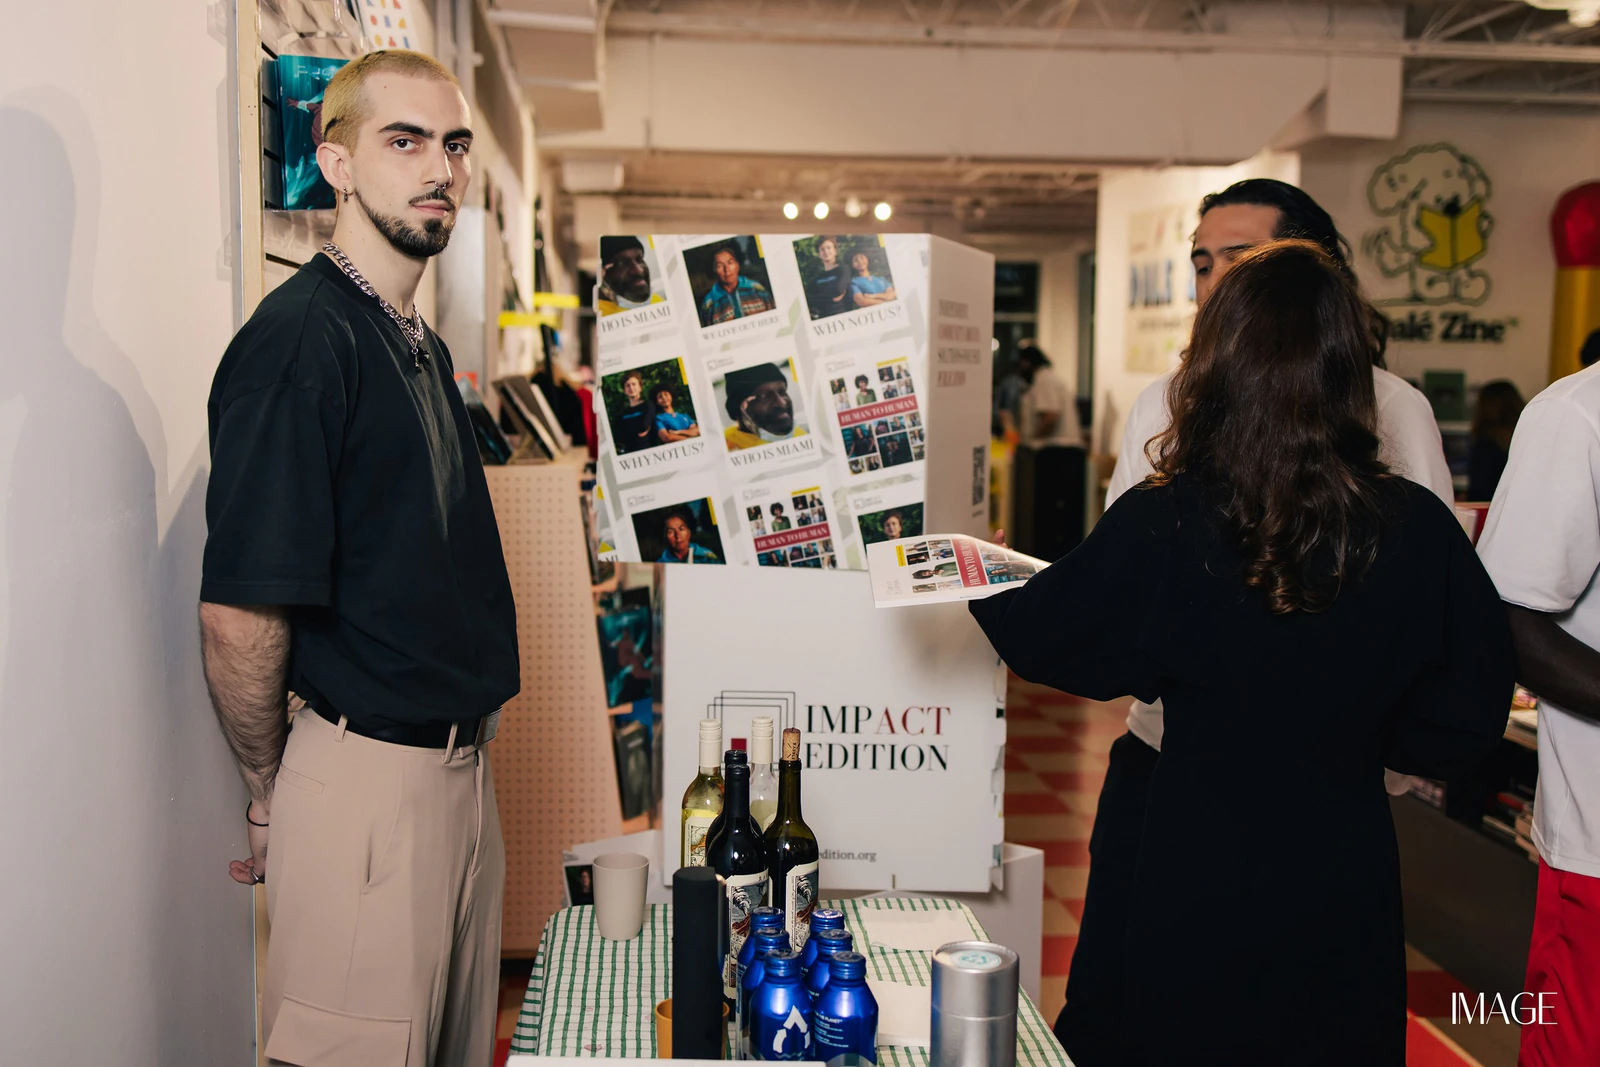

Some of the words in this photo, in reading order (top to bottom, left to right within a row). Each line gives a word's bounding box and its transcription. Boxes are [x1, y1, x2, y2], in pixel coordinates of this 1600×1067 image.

[601, 319, 620, 332] HO
[633, 305, 671, 323] MIAMI
[813, 320, 845, 336] WHY
[848, 312, 875, 328] NOT
[1390, 310, 1434, 342] alé
[619, 455, 651, 471] WHY
[653, 446, 680, 462] NOT
[730, 453, 761, 467] WHO
[776, 438, 814, 456] MIAMI
[804, 704, 952, 736] IMPACT
[804, 742, 951, 771] EDITION
